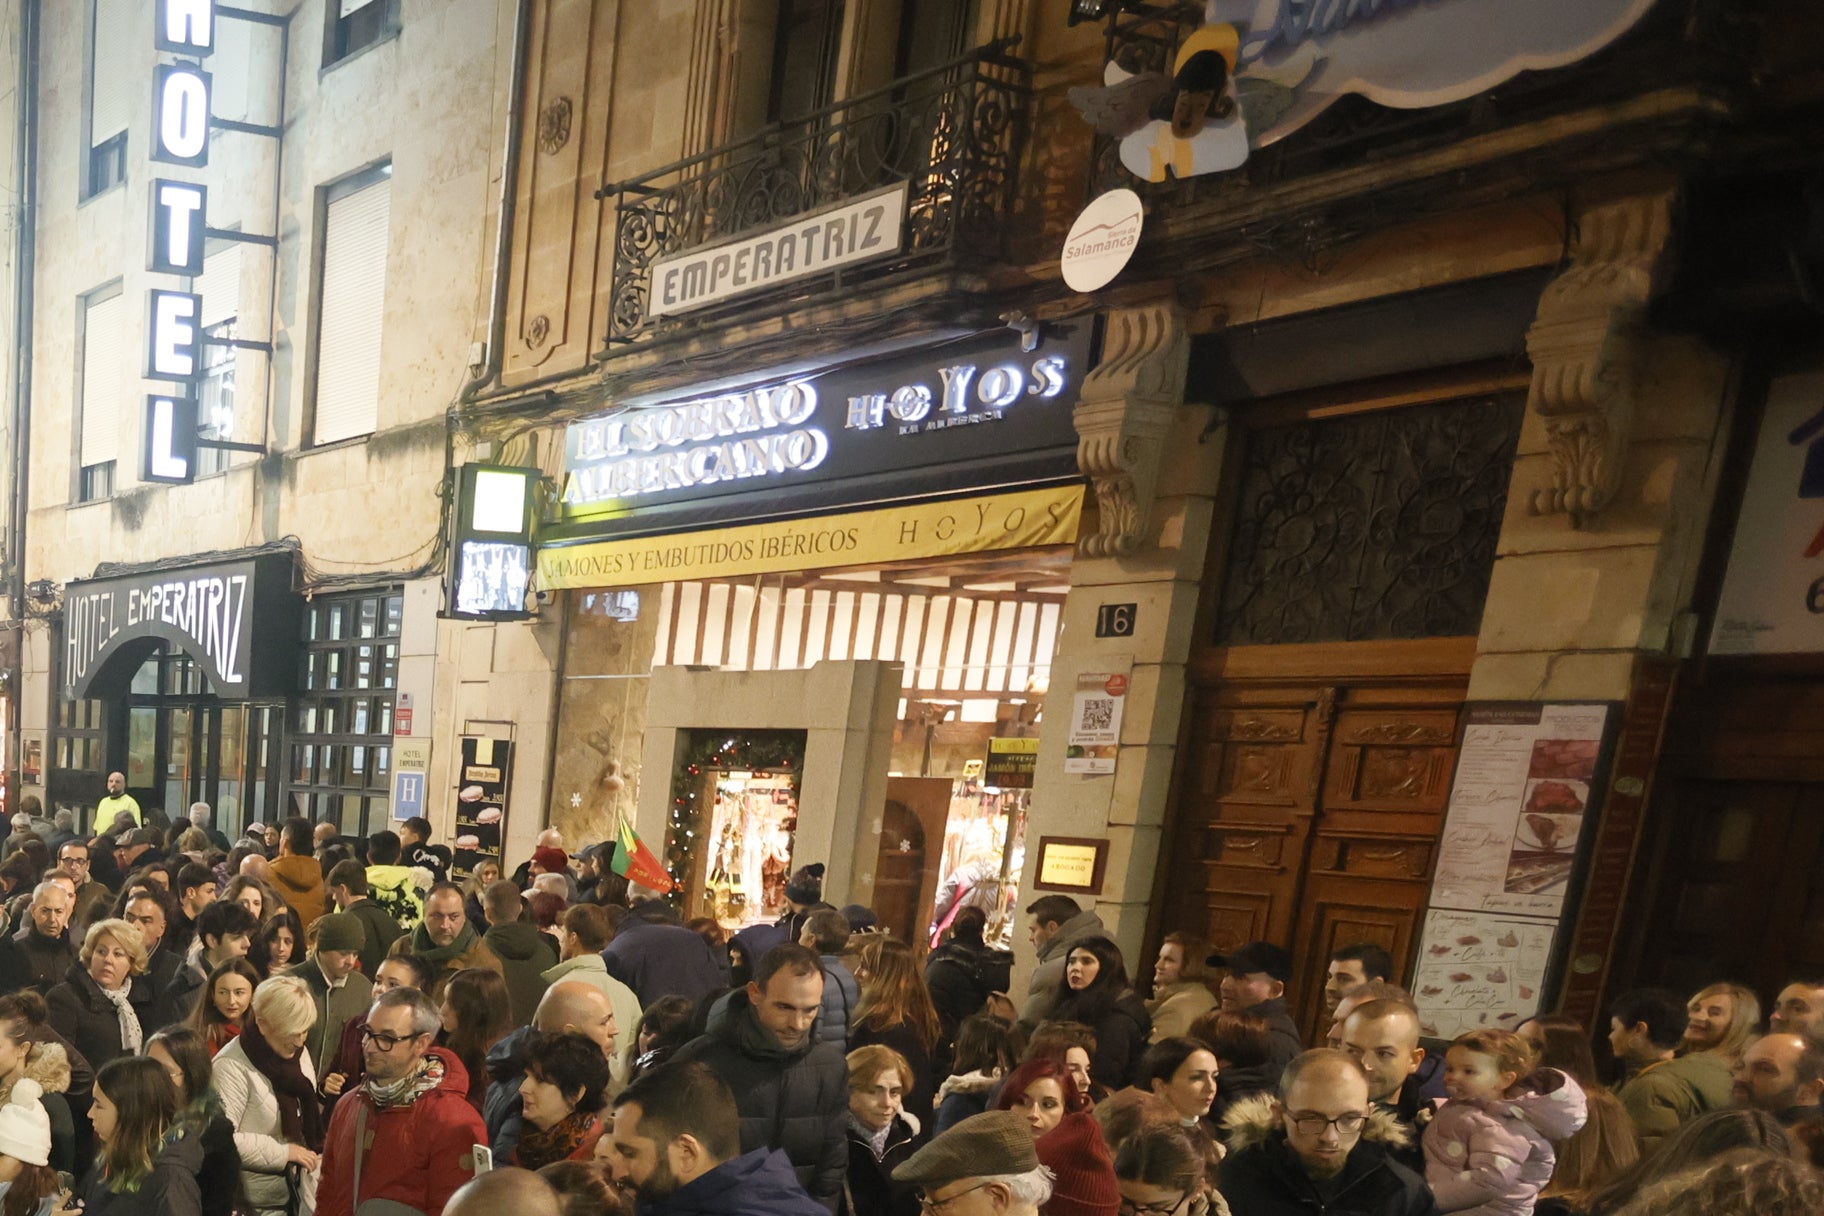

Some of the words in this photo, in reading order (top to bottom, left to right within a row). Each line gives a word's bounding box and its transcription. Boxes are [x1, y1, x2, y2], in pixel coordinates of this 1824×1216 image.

[662, 204, 885, 306] EMPERATRIZ
[1065, 234, 1135, 260] Salamanca
[843, 355, 1066, 430] HOYOS
[561, 427, 829, 504] ALBERCANO
[547, 552, 624, 579] JAMONES
[628, 551, 641, 572] Y
[643, 538, 755, 571] EMBUTIDOS
[758, 527, 859, 560] IBÉRICOS
[898, 501, 1062, 545] HOYOS
[65, 591, 120, 687] HOTEL
[127, 574, 248, 684] EMPERATRIZ
[1101, 606, 1129, 634] 16
[399, 759, 425, 768] EMPERATRIZ
[403, 749, 422, 759] HOTEL
[401, 777, 418, 803] H
